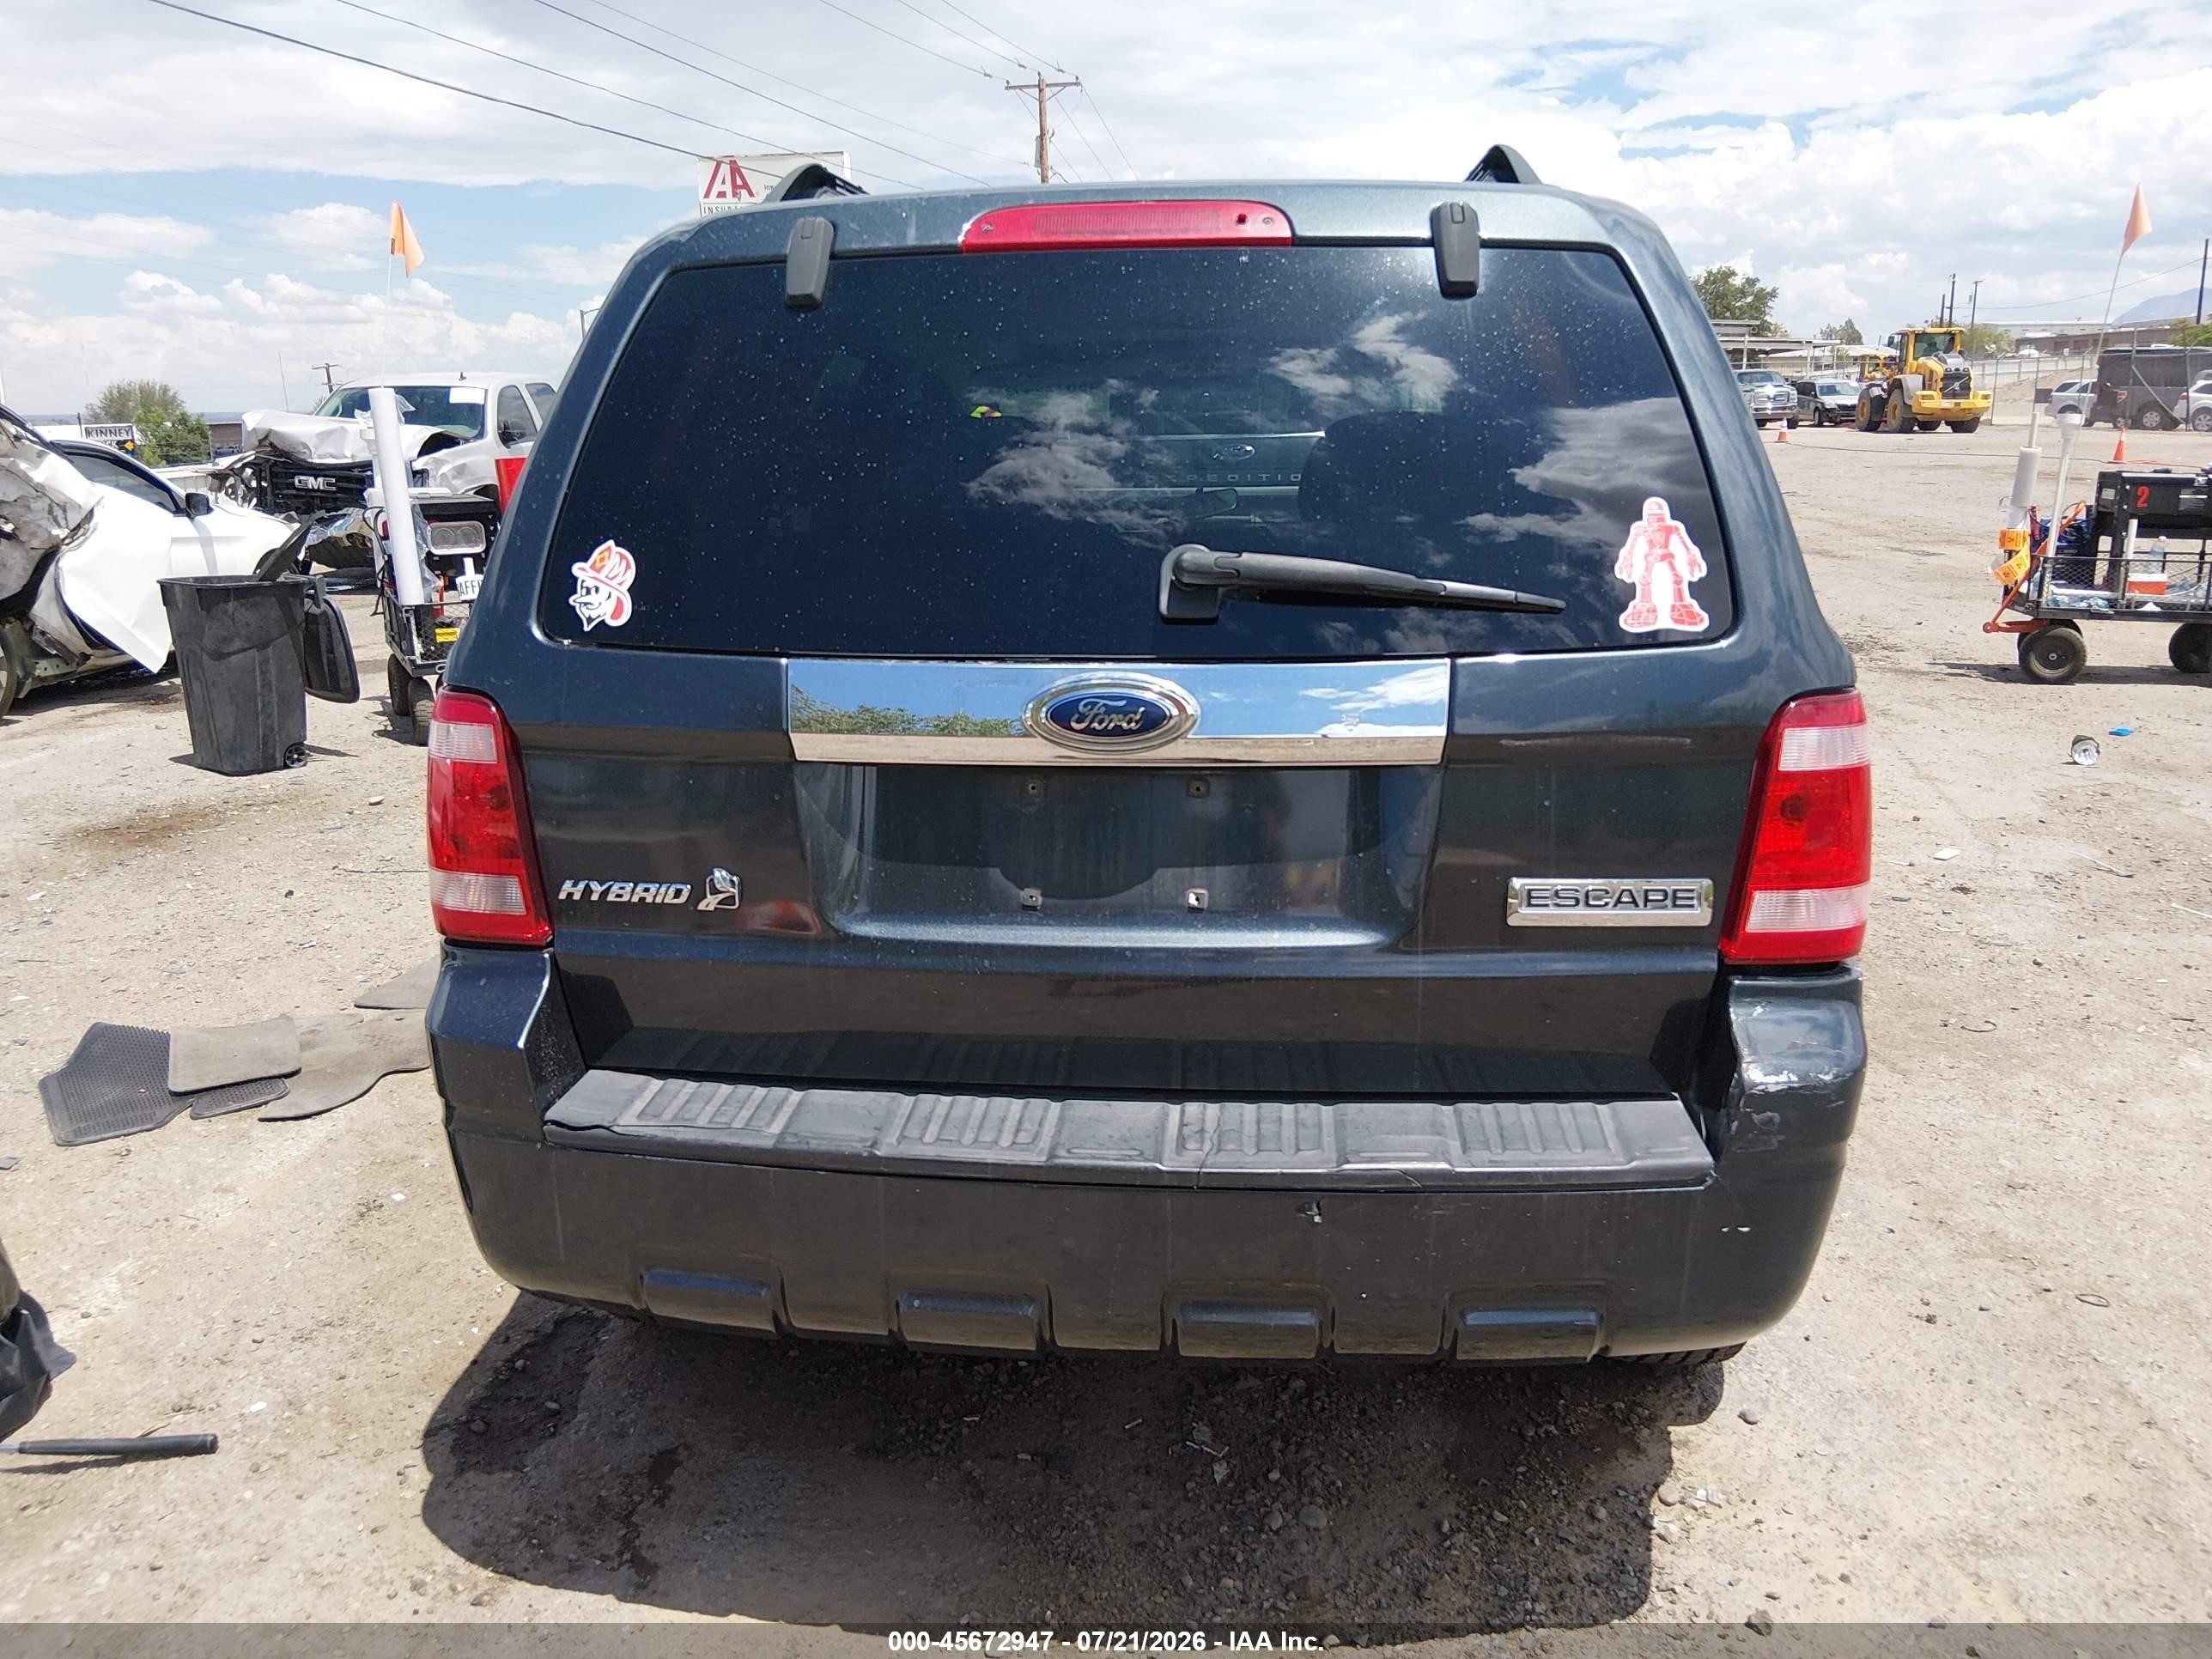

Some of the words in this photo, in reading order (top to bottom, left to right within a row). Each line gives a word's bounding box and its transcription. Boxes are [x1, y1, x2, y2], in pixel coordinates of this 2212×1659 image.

[87, 428, 131, 439] KINNEY
[295, 475, 337, 491] GMC
[1146, 473, 1302, 483] EXPEDITIO
[2136, 484, 2150, 509] 2
[1070, 697, 1146, 731] Ford
[558, 878, 691, 904] HYBRID
[1523, 885, 1698, 908] ESCAPE
